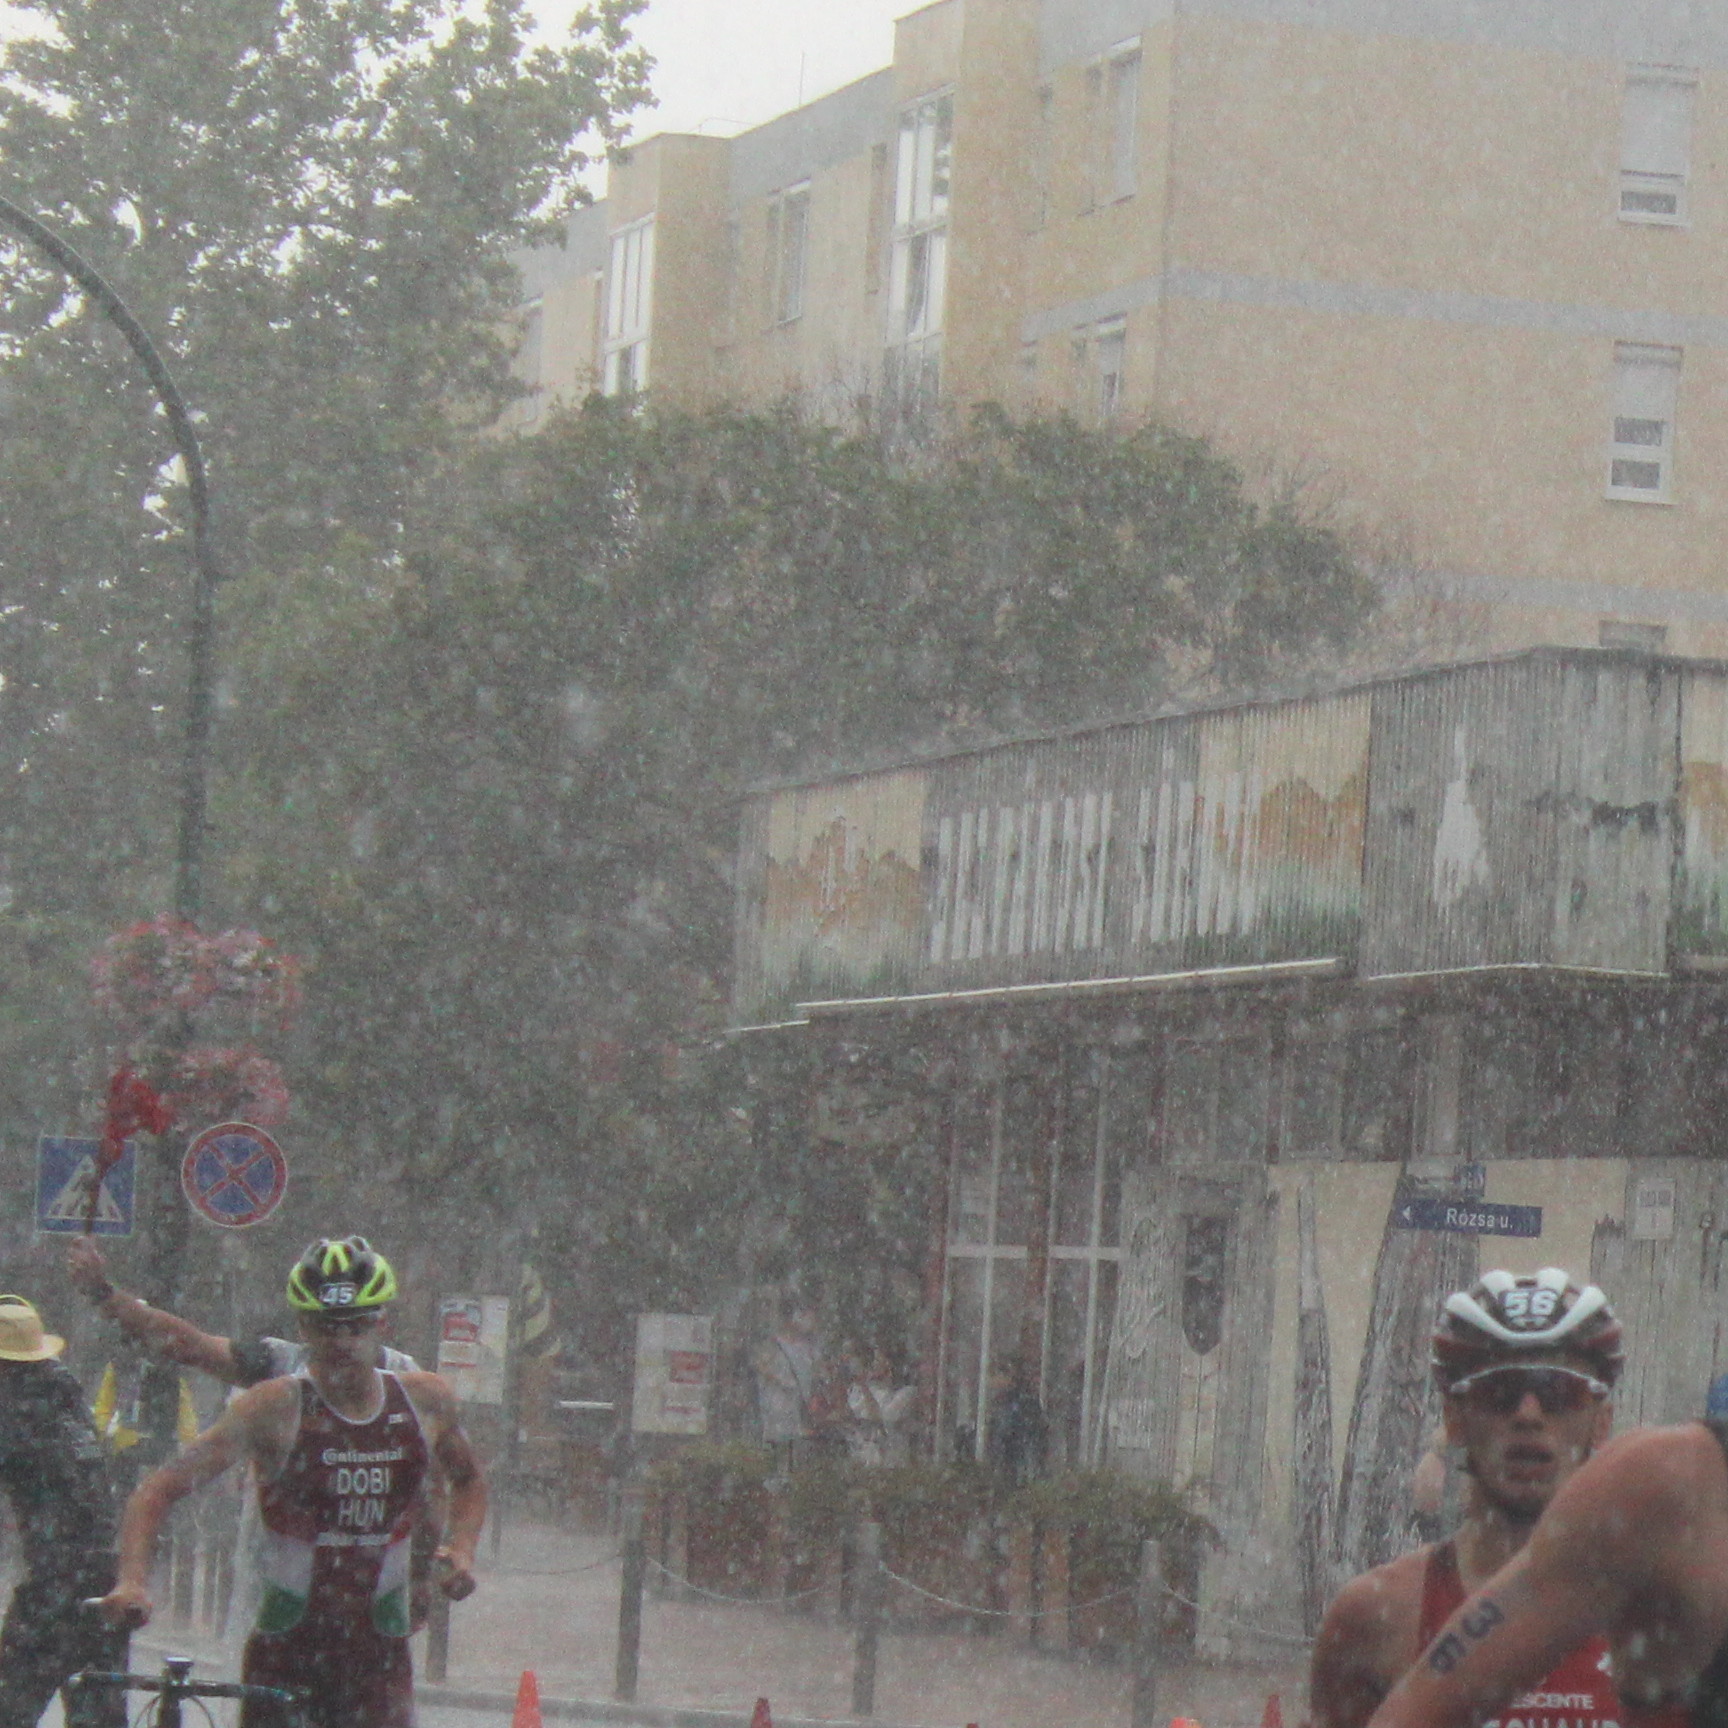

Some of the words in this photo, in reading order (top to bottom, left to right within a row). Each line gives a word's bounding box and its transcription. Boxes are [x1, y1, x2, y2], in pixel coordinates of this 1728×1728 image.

[1446, 1207, 1494, 1228] Rózsa
[1500, 1214, 1514, 1229] u.
[320, 1286, 354, 1305] 45
[1505, 1290, 1558, 1317] 56
[336, 1467, 391, 1495] DOBI
[338, 1498, 386, 1527] HUN
[1511, 1693, 1594, 1710] SCENTE
